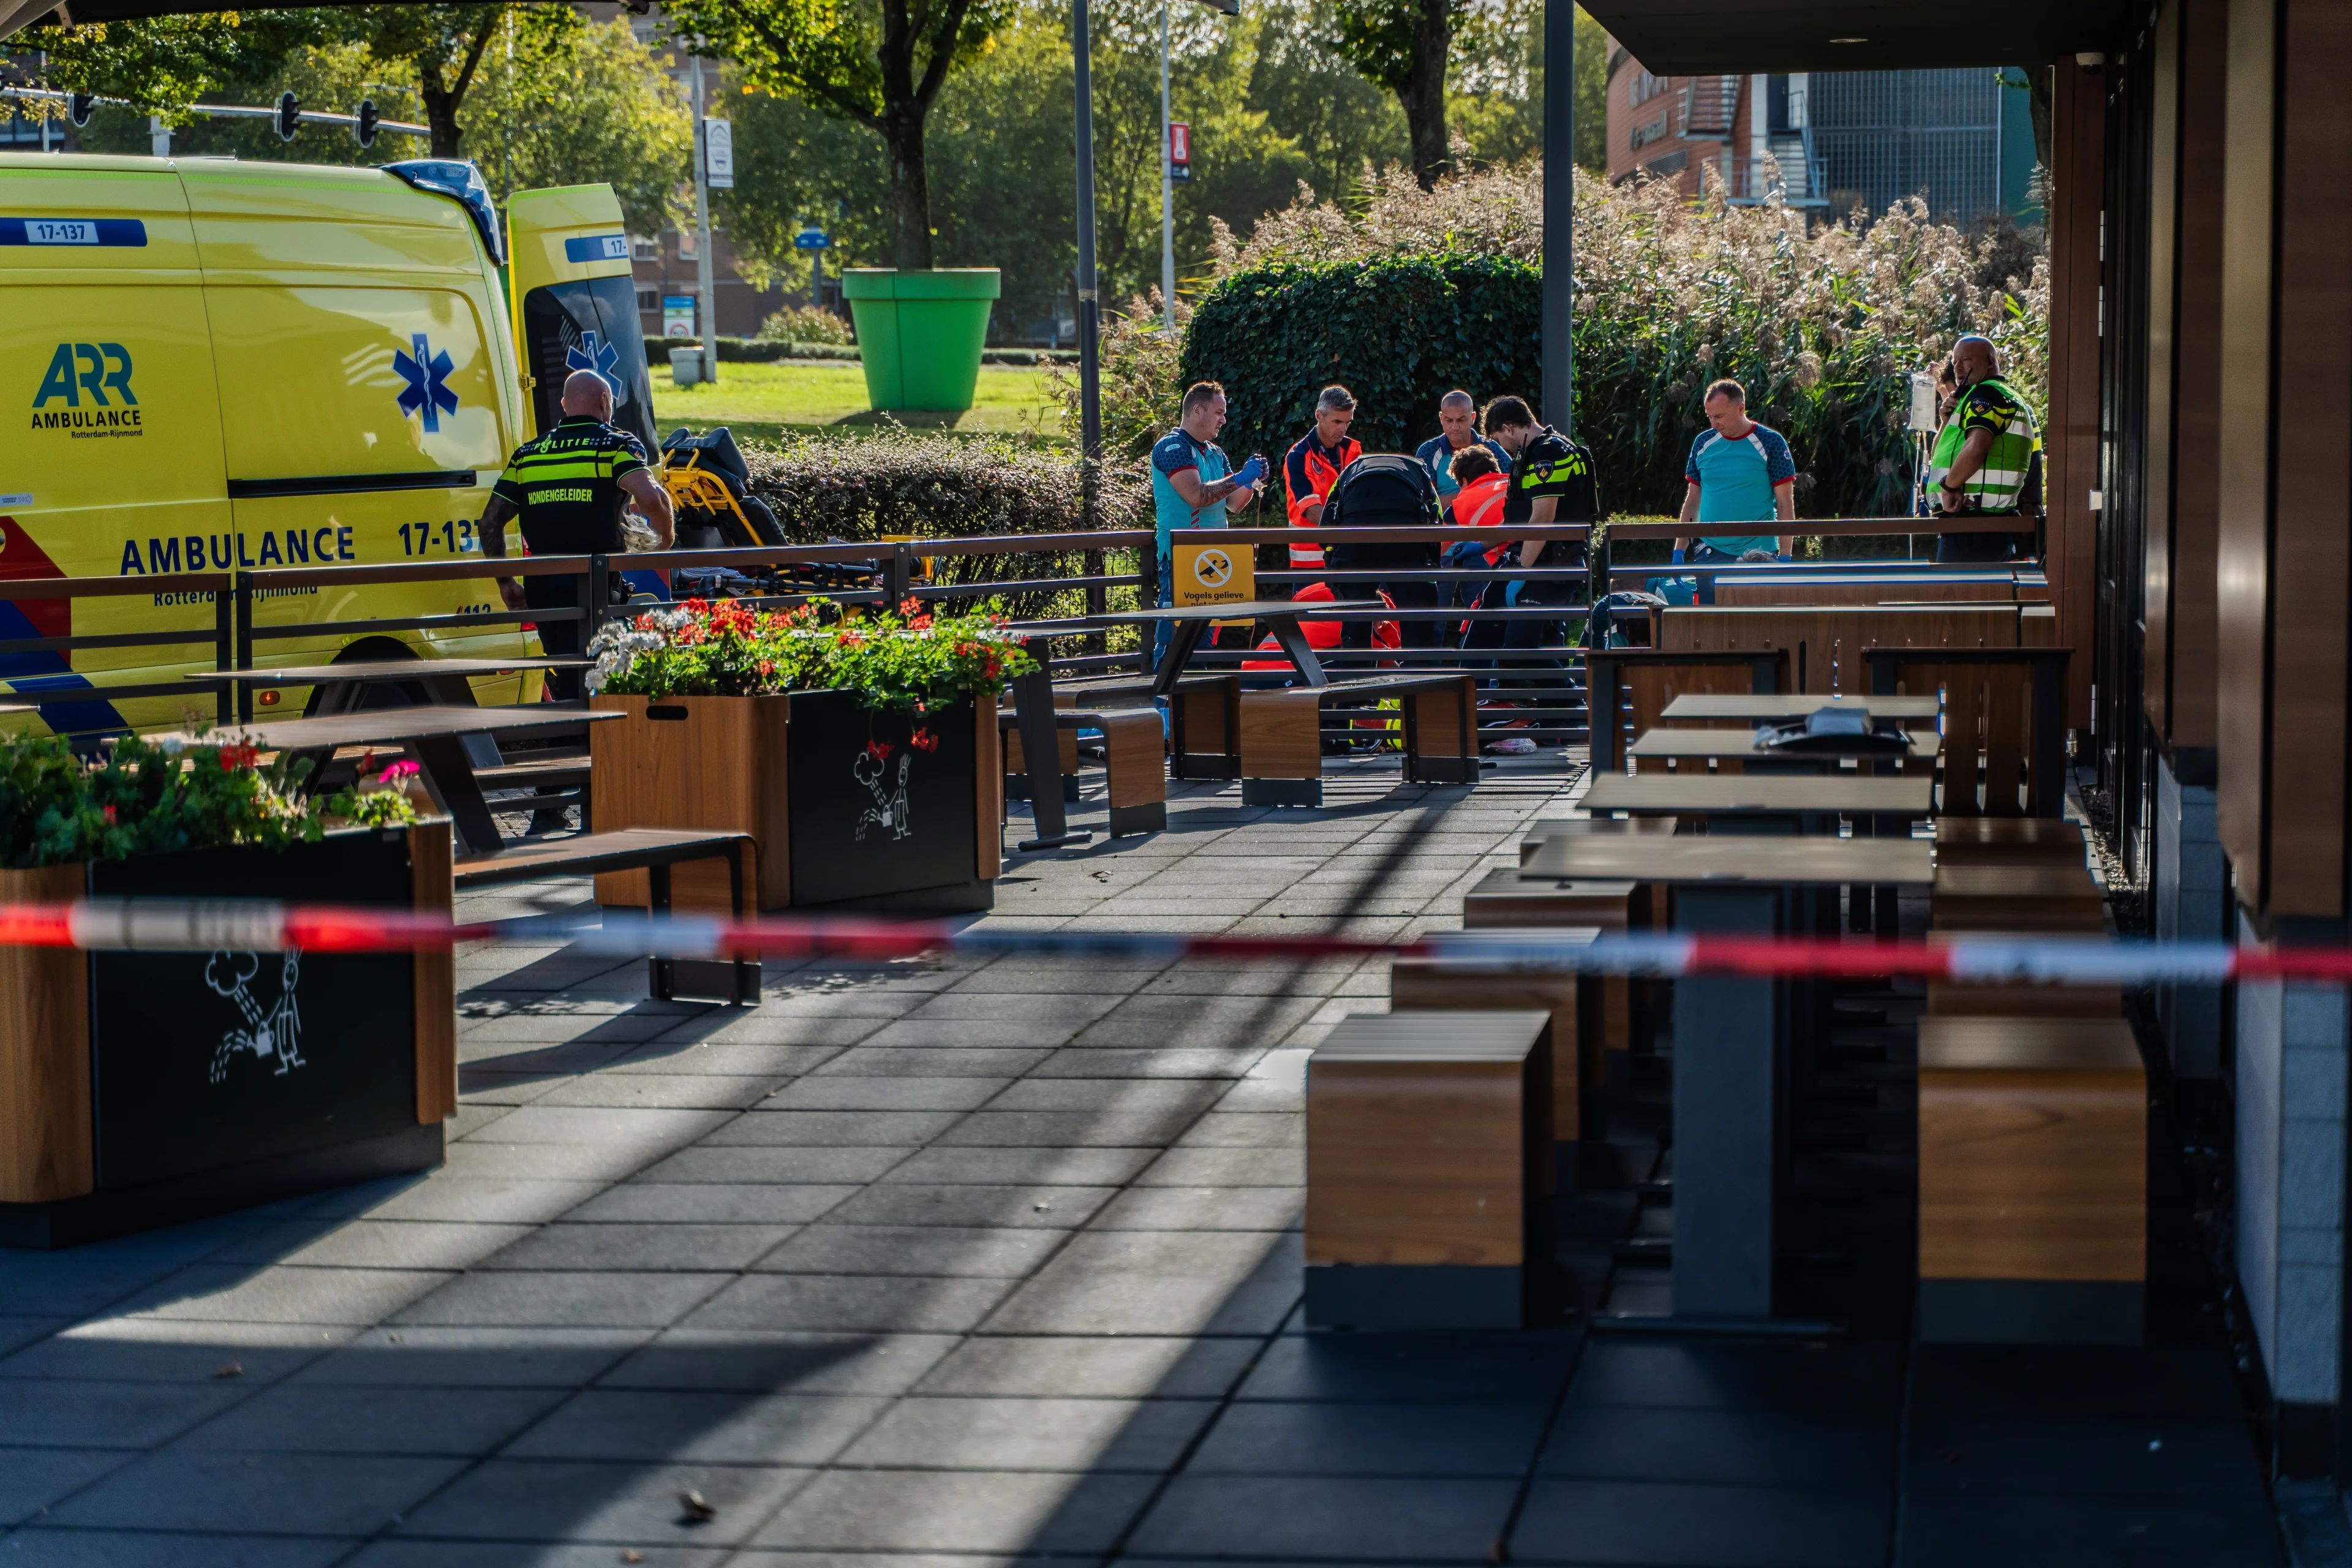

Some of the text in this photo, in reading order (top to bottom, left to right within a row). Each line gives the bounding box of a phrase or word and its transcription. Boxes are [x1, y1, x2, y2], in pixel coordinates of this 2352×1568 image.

[37, 224, 85, 240] 17-137
[32, 343, 139, 408] ARR
[31, 410, 142, 429] AMBULANCE
[71, 428, 143, 439] Rotterdam-Rijnmond
[533, 434, 590, 454] POLITIE
[528, 488, 592, 505] HONDENGELEIDER
[120, 526, 355, 576] AMBULANCE
[1184, 591, 1244, 601] Vogels gelieve
